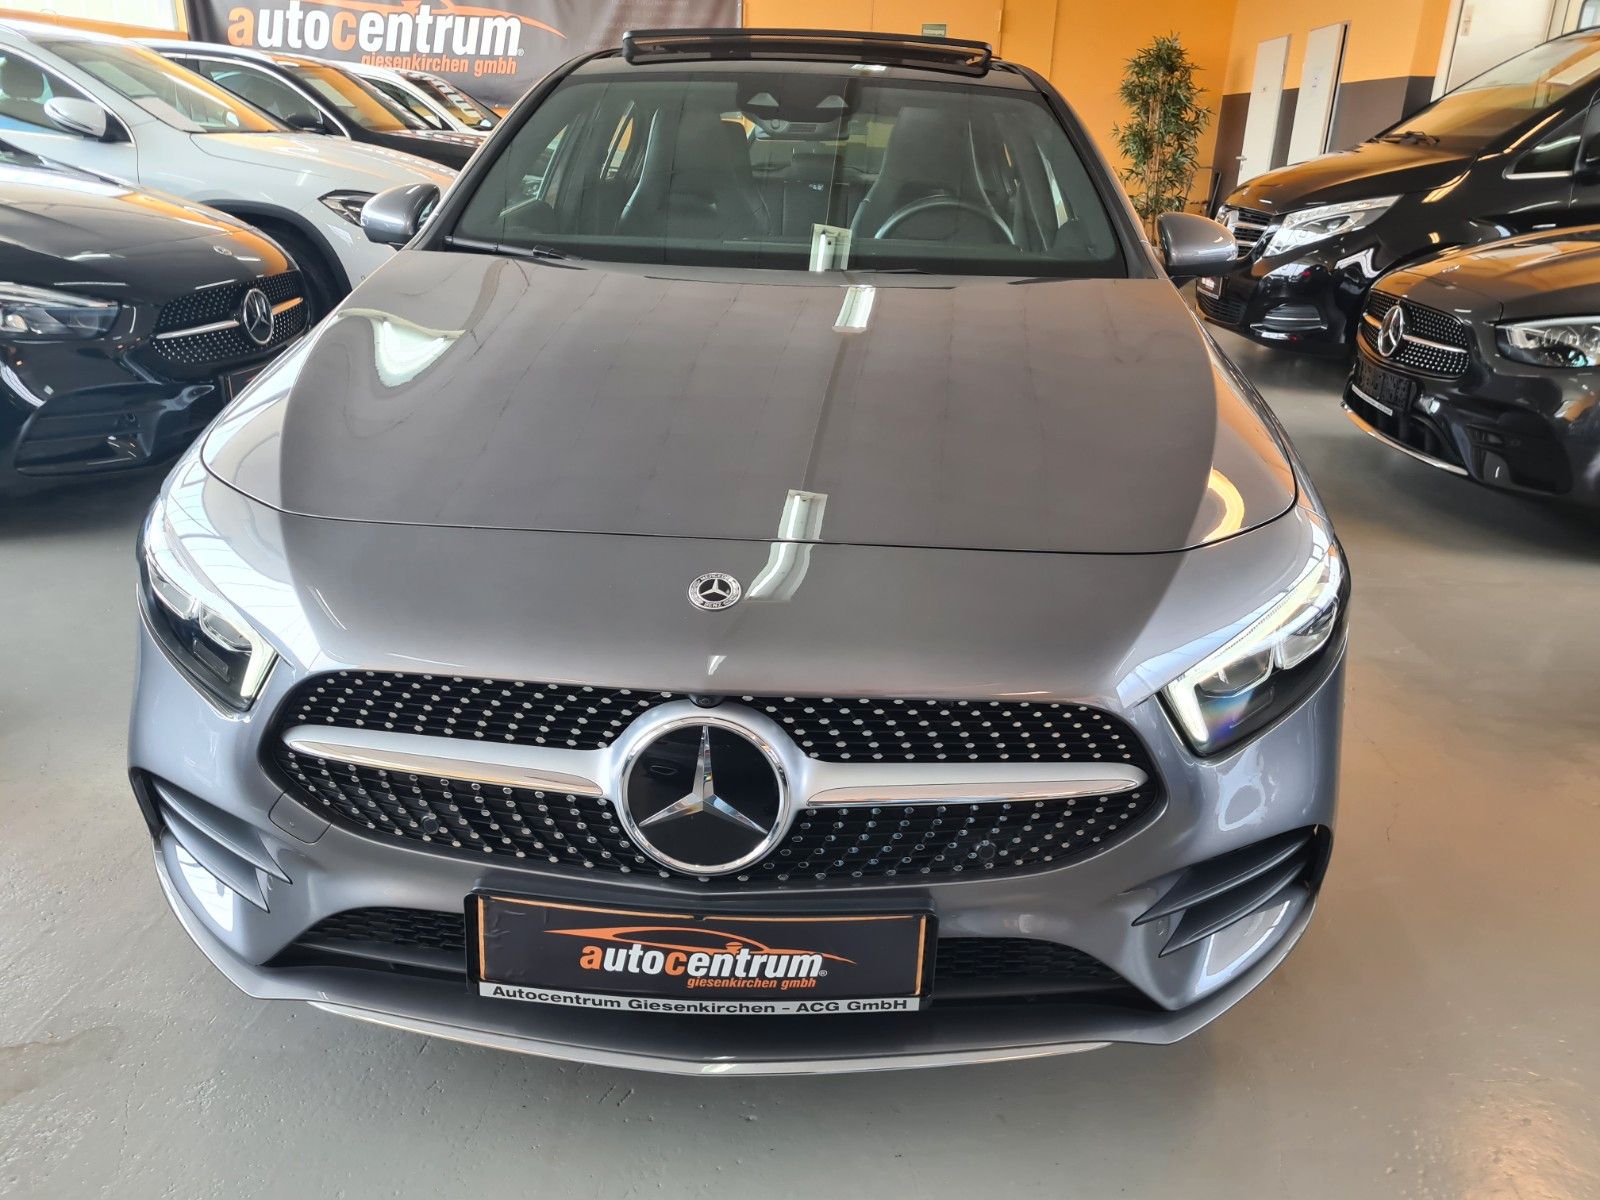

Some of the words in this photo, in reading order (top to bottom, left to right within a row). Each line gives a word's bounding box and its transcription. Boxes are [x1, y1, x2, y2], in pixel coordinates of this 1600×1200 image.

[474, 57, 521, 77] gmbh
[687, 976, 777, 989] giesenkirchen
[781, 978, 817, 991] gmbh
[492, 985, 621, 1008] Autocentrum
[627, 999, 776, 1013] Giesenkirchen
[796, 1002, 840, 1012] ACG
[847, 999, 908, 1010] GmbH
